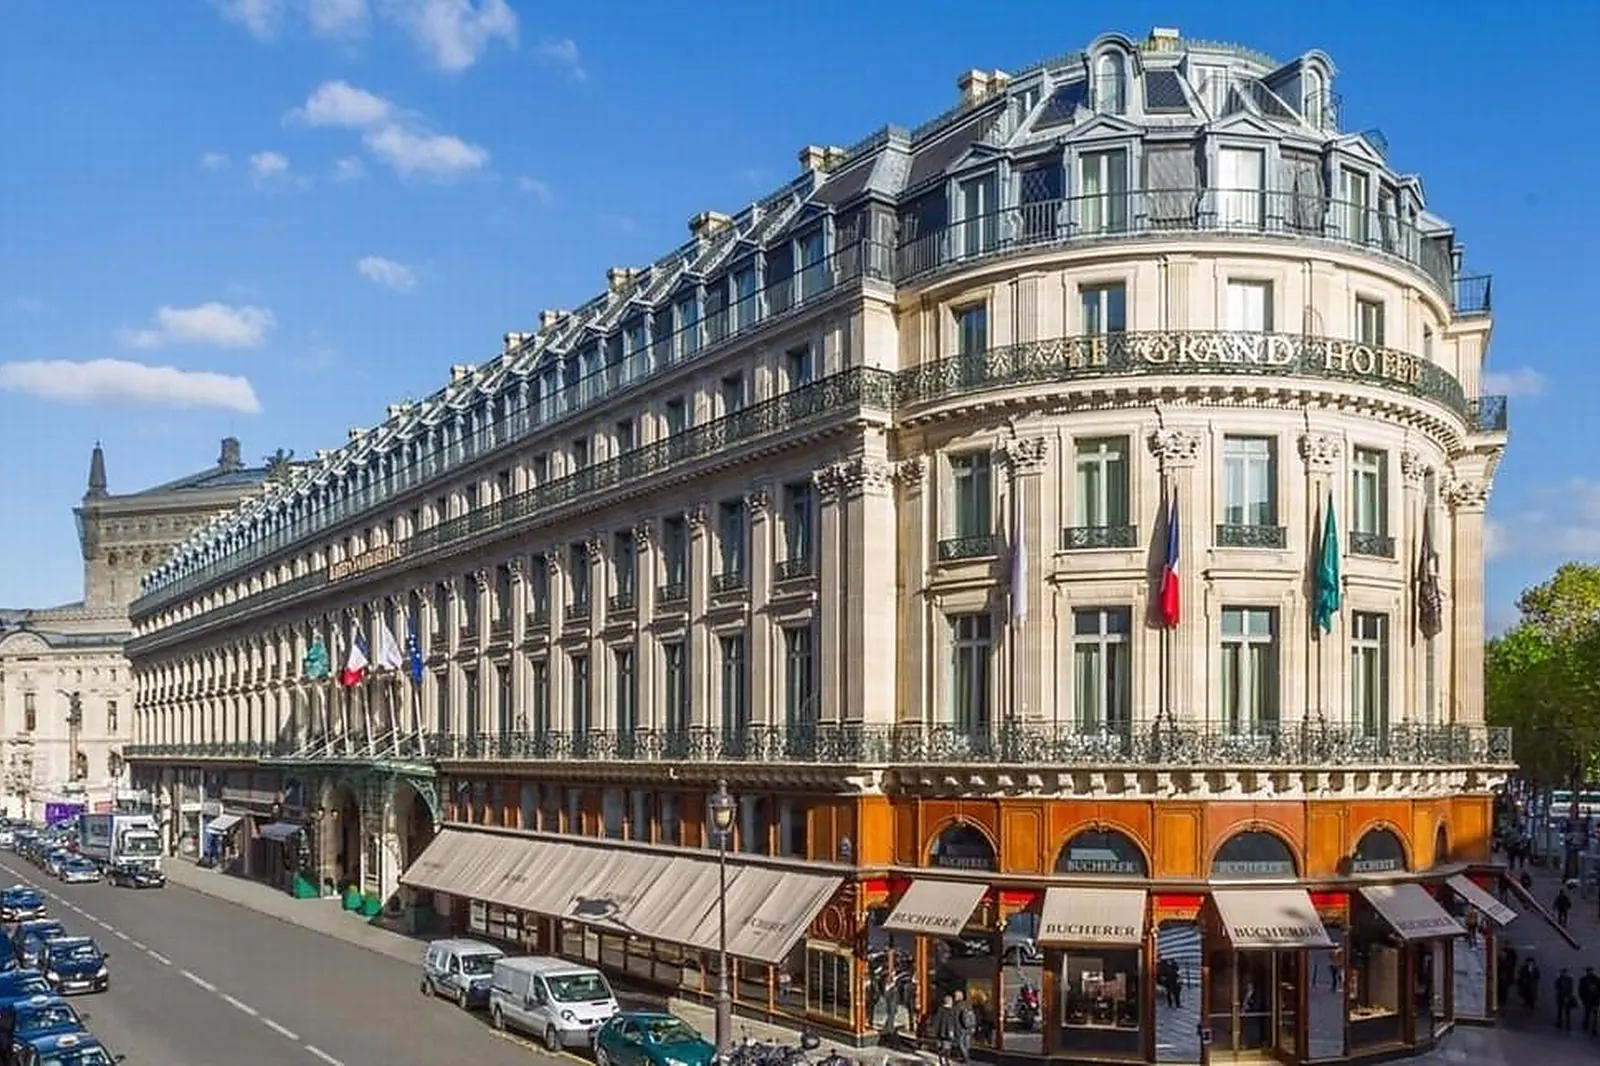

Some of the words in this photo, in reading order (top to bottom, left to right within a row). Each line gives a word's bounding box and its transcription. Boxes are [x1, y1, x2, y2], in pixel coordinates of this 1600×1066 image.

[1142, 334, 1295, 365] GRAND
[1066, 859, 1136, 873] BUCHERER
[1046, 923, 1137, 938] BUCHERER
[1233, 925, 1322, 938] BUCHERER
